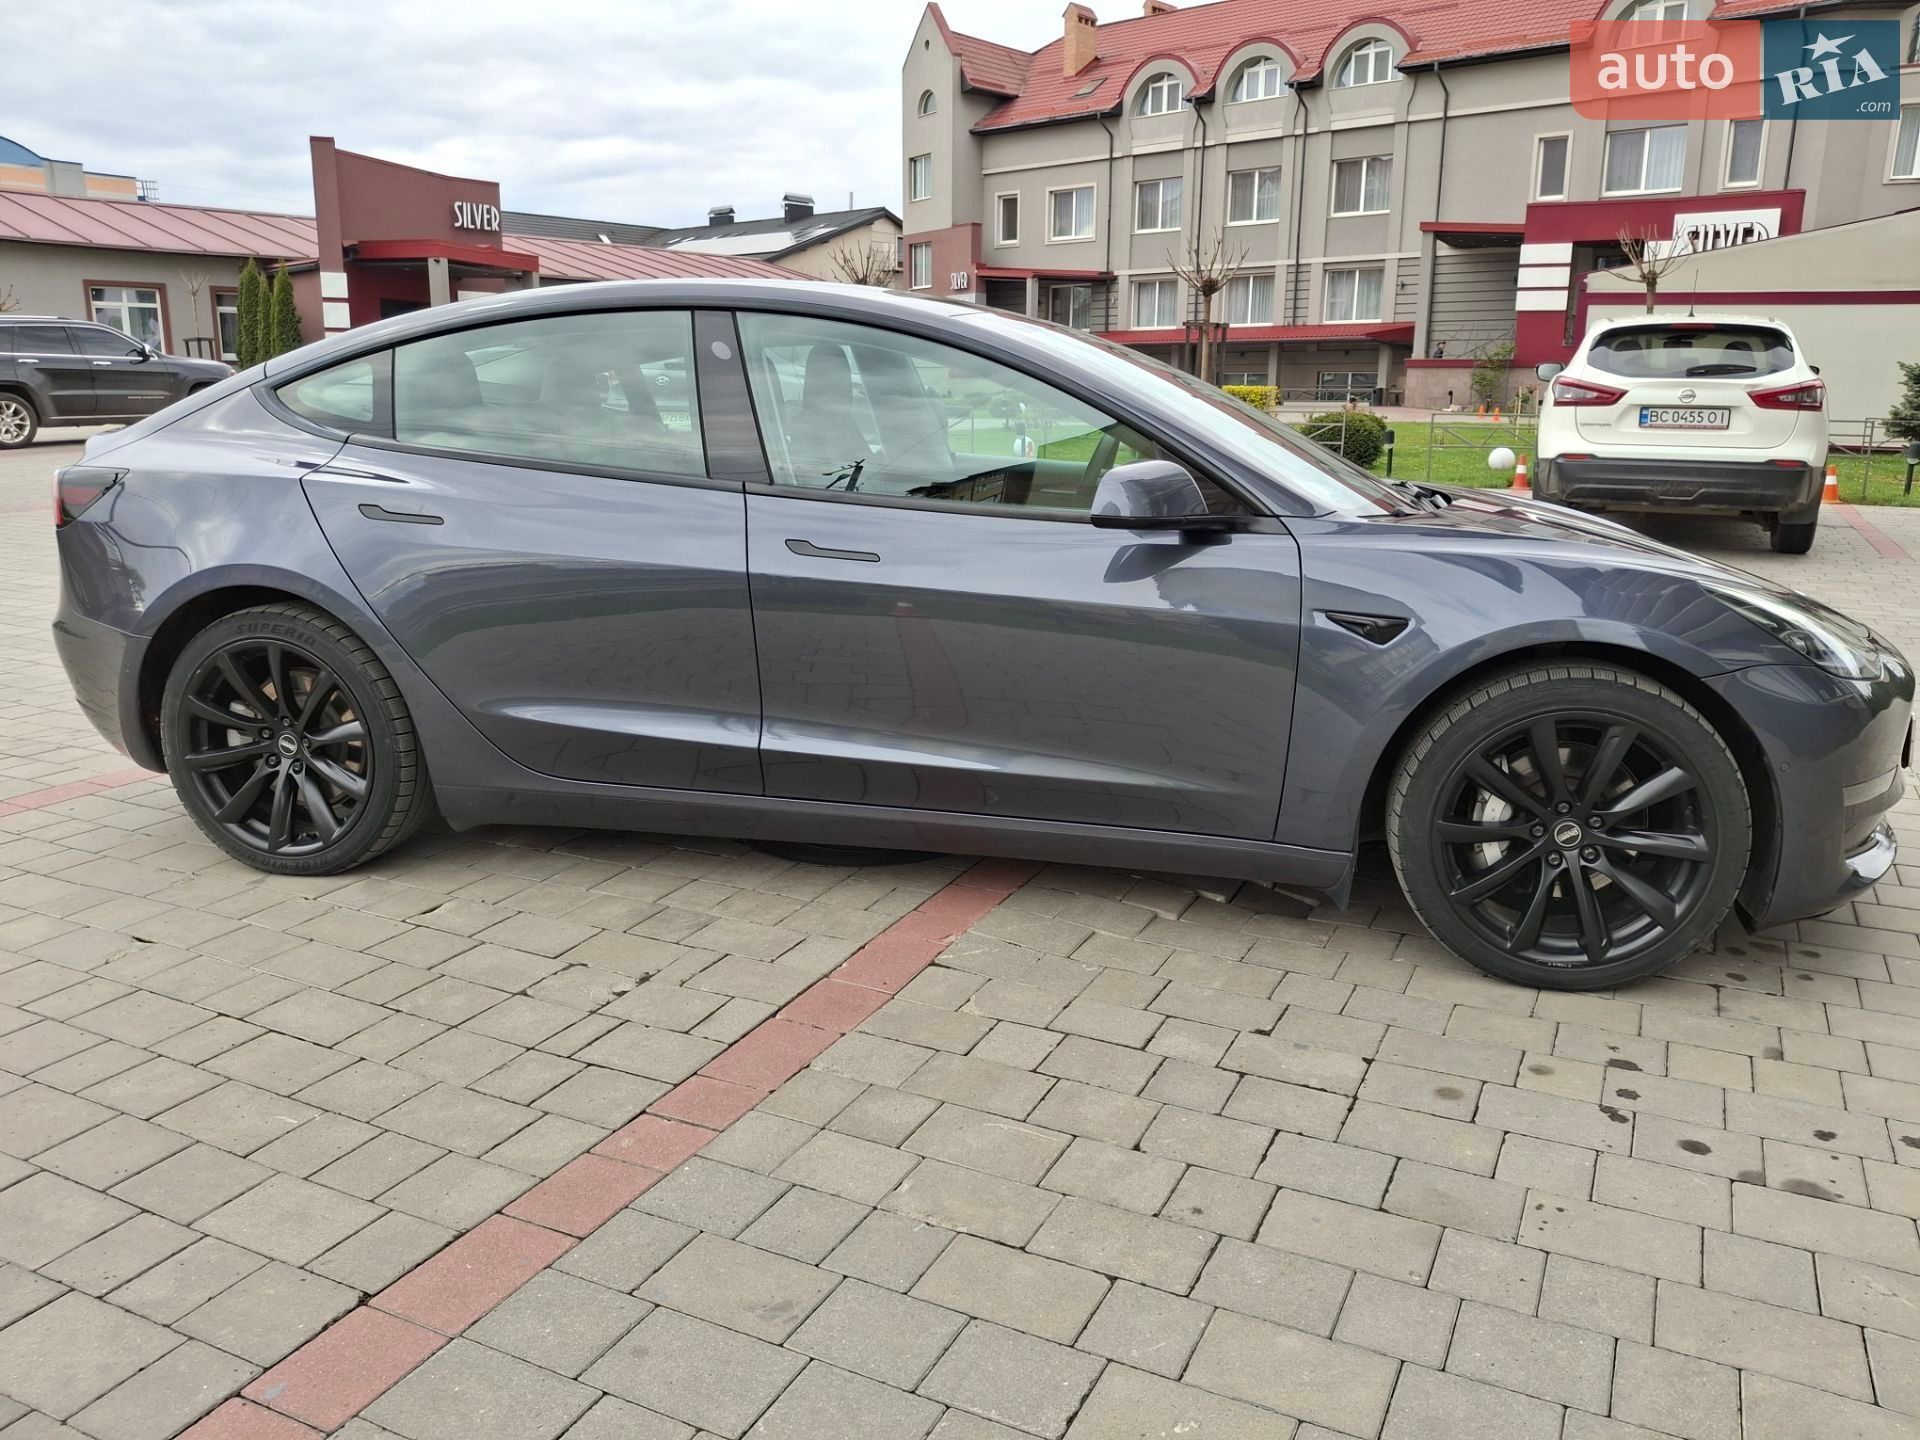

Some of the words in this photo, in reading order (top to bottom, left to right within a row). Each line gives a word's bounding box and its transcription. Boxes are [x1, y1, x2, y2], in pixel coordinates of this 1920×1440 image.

[453, 201, 500, 232] SILVER
[1649, 410, 1670, 423] BC
[1671, 410, 1705, 424] 0455
